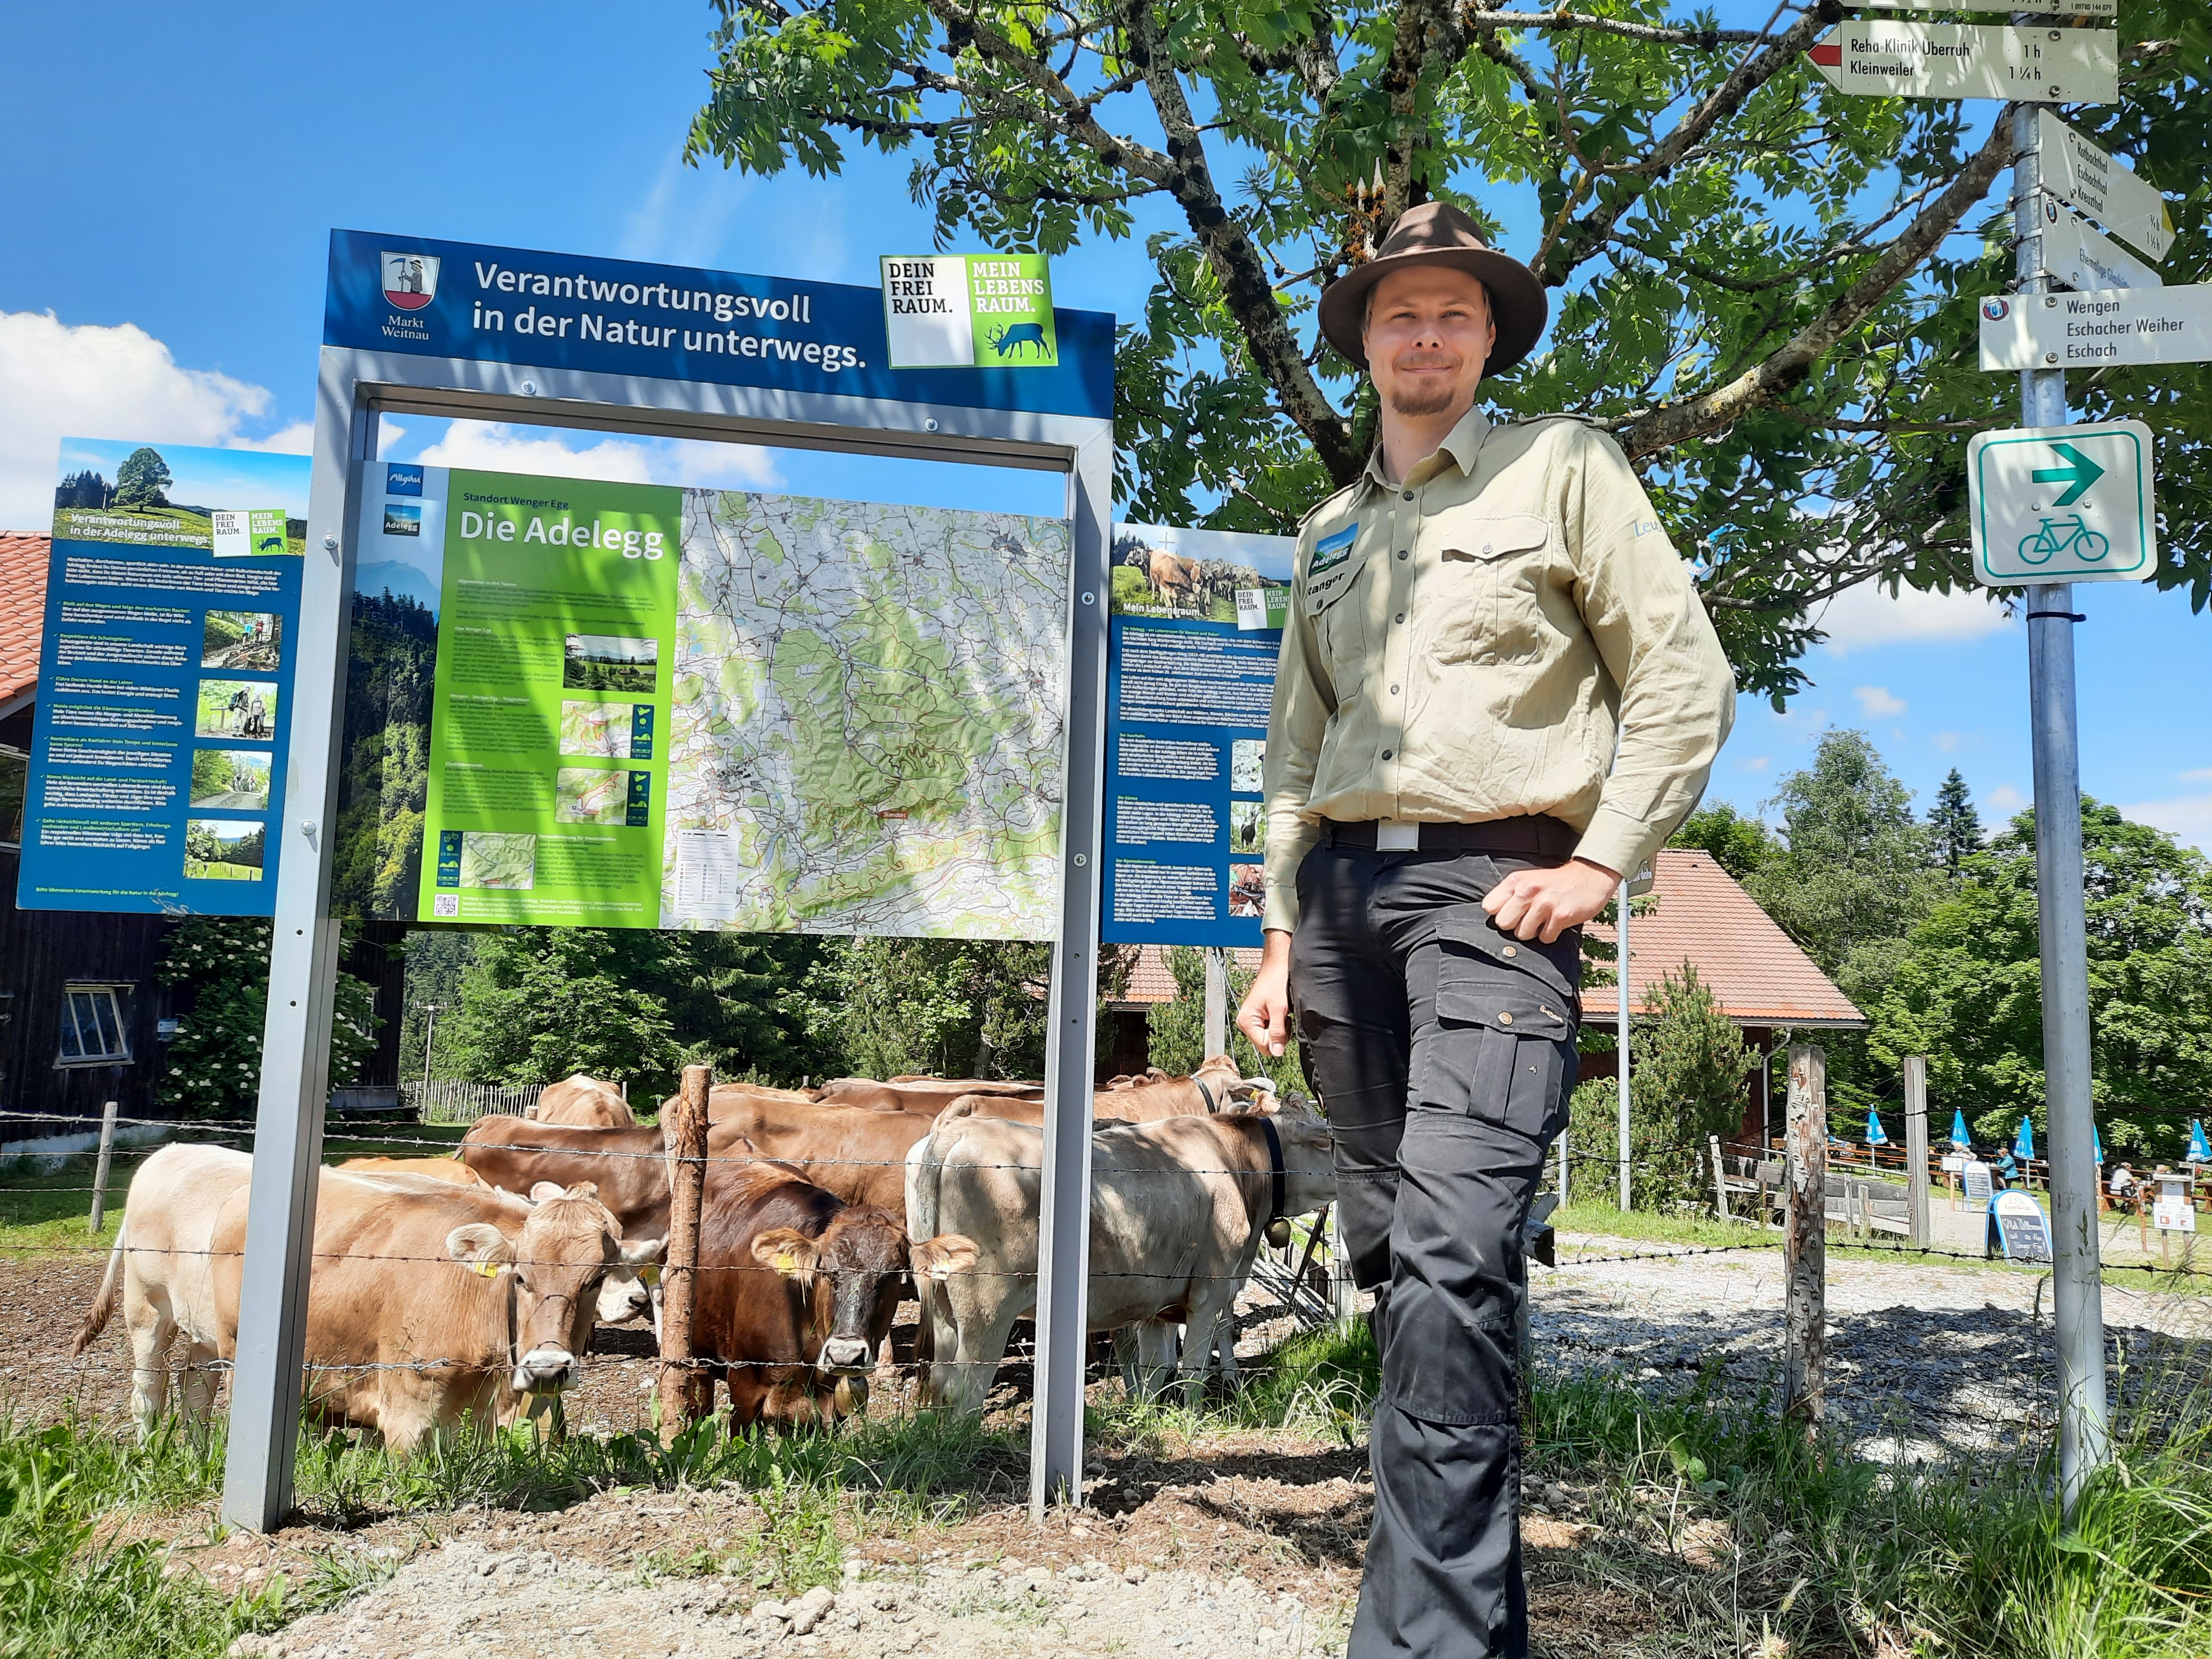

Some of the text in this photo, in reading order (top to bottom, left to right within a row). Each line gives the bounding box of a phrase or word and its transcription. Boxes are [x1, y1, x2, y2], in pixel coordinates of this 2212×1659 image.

[1851, 36, 2042, 58] Reha-Klinik Überruh 1 h
[1850, 60, 1913, 77] Kleinweiler
[2009, 66, 2015, 80] 1
[2034, 66, 2041, 80] h
[2078, 185, 2103, 213] Kreuzthal
[889, 263, 934, 278] DEIN
[973, 262, 1020, 277] MEIN
[2079, 248, 2106, 279] Ehemalige
[474, 262, 810, 324] Verantwortungsvoll
[890, 281, 932, 295] FREI
[974, 279, 1044, 295] LEBENS
[892, 299, 953, 314] RAUM.
[975, 297, 1036, 312] RAUM.
[2067, 300, 2120, 316] Wengen
[388, 315, 424, 328] Markt
[2067, 317, 2184, 336] Eschacher Weiher
[381, 326, 429, 340] Weitnau
[473, 300, 866, 372] in der Natur unterwegs.
[2067, 342, 2117, 358] Eschach
[463, 493, 568, 510] Standort Wenger Egg
[71, 513, 180, 529] Verantwortungsvoll
[385, 521, 418, 531] Adelegg
[70, 526, 211, 545] in der Adelegg unterwegs.
[460, 511, 664, 561] Die Adelegg
[1312, 547, 1349, 569] Adelegg
[1123, 603, 1203, 616] Mein Lebensraum.
